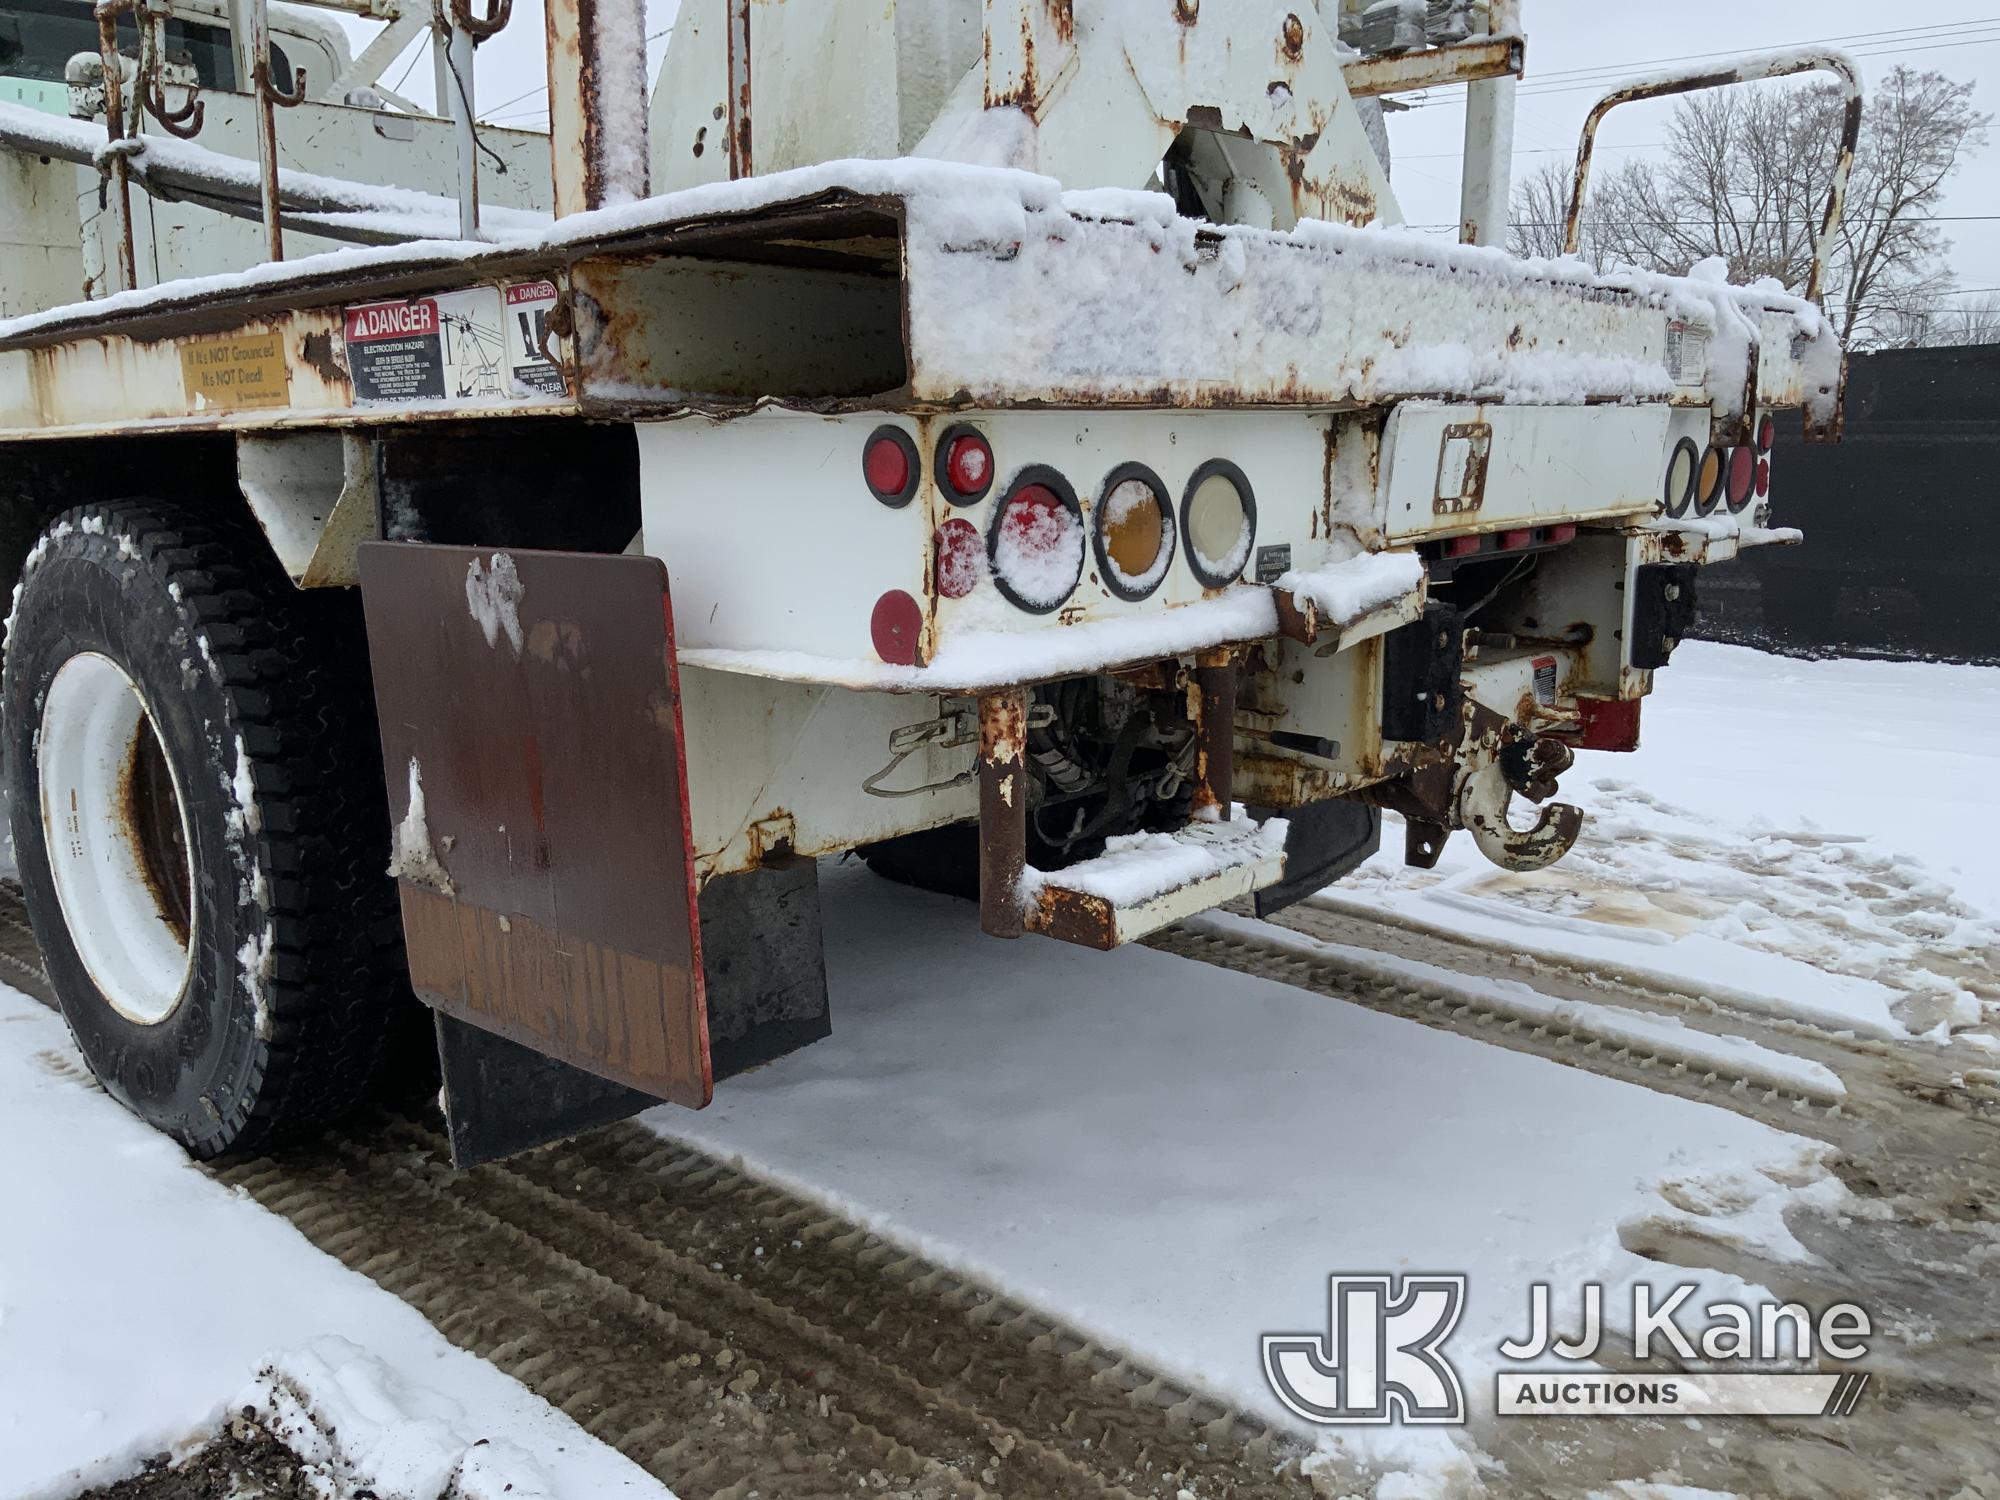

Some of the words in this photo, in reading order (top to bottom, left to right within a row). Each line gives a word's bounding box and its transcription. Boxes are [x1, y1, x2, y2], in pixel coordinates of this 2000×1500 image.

[520, 286, 554, 300] DANGER
[369, 304, 431, 335] DANGER
[209, 346, 229, 363] NOT
[231, 340, 275, 361] Grounded
[363, 343, 404, 355] ELECTROCUTION
[404, 340, 425, 351] HAZARD
[215, 369, 236, 386] NOT
[541, 382, 562, 392] CLEAR
